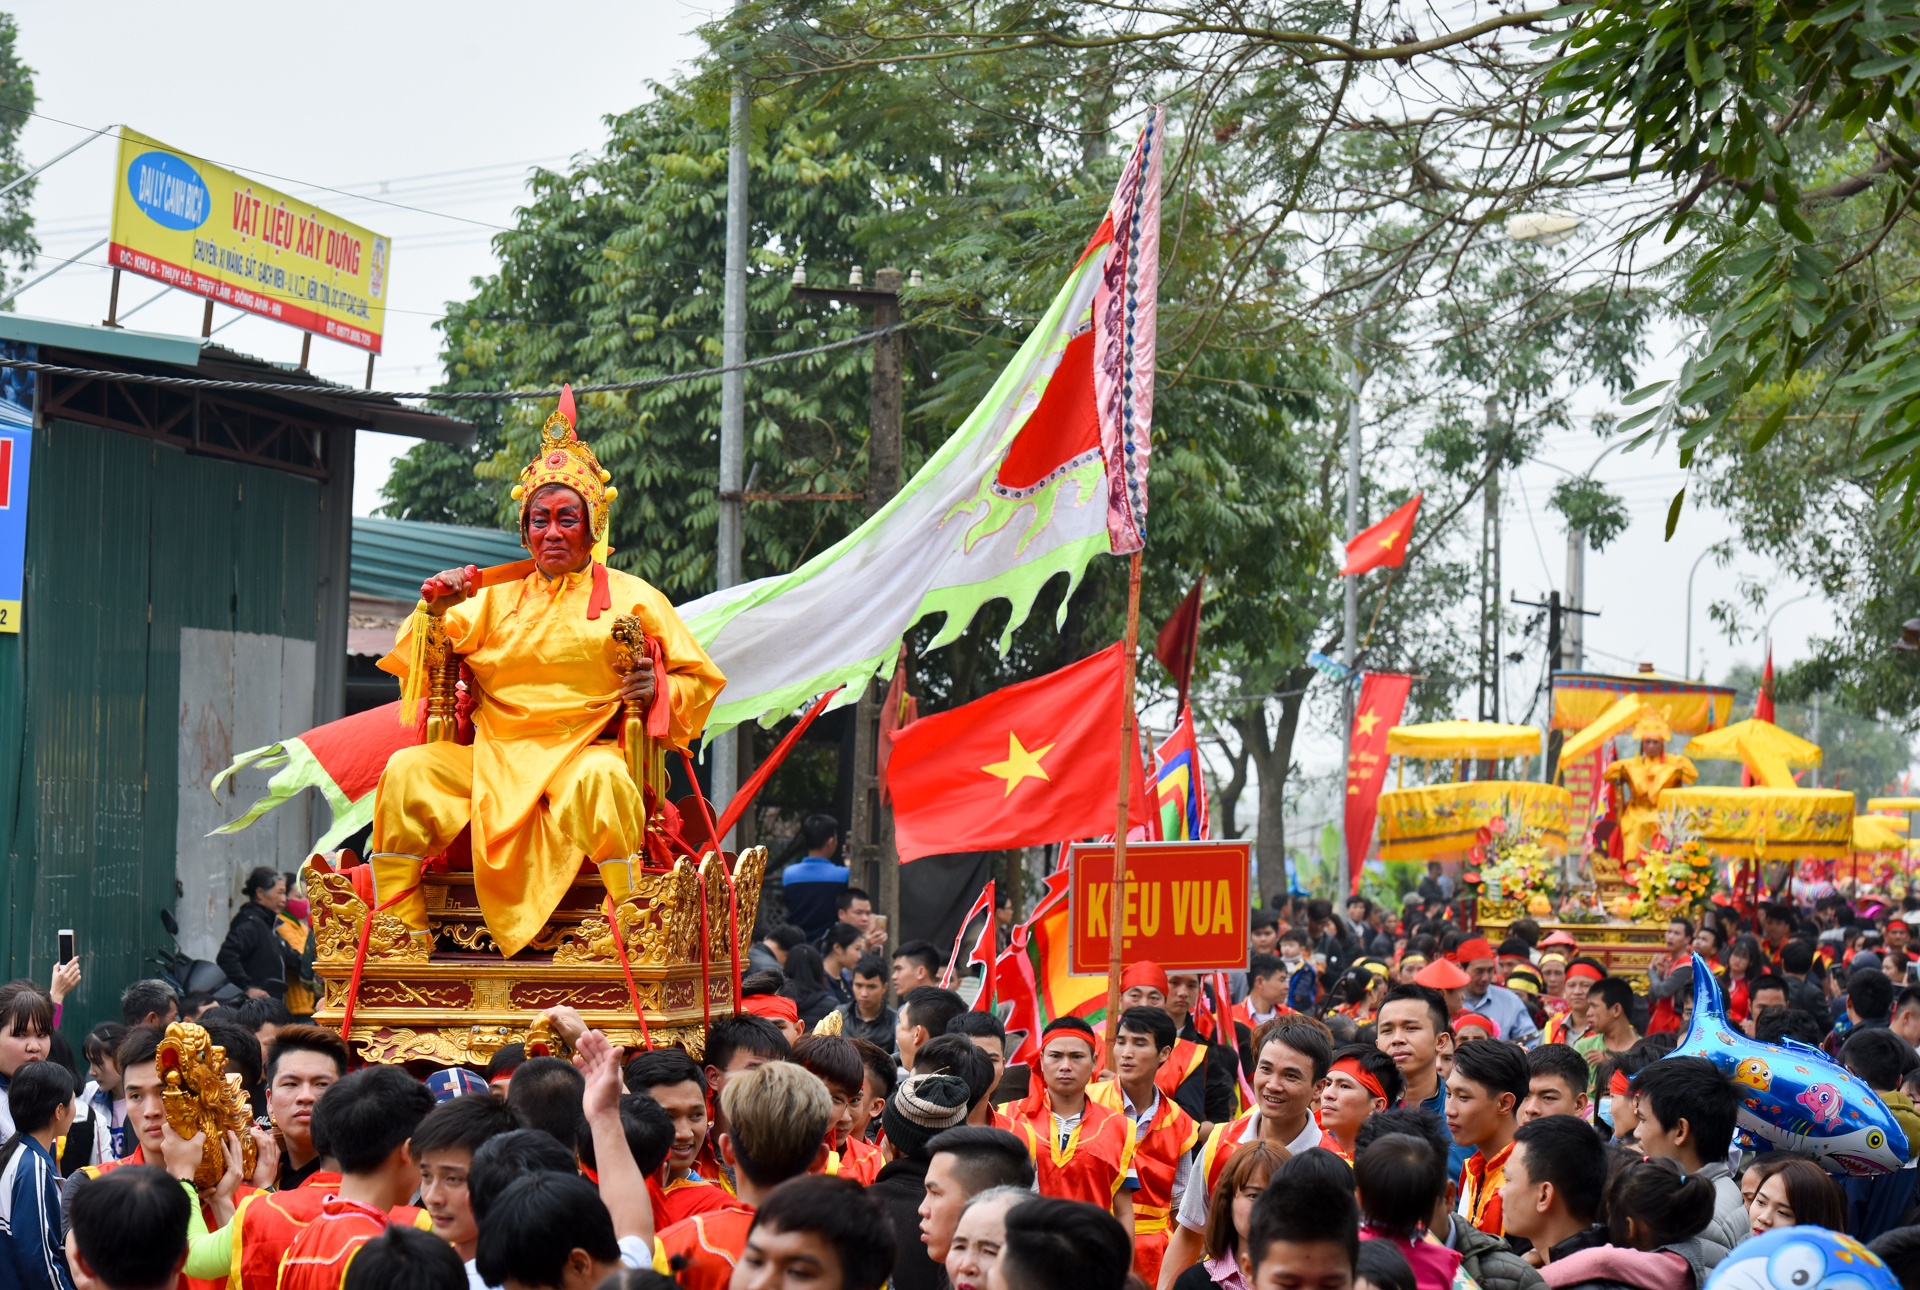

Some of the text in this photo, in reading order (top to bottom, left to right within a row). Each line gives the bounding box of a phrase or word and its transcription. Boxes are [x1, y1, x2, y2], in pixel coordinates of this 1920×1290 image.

[153, 161, 166, 208] LÝ
[233, 187, 361, 277] VẬT LIỆU XÂY DỰNG
[134, 254, 151, 272] KHU
[151, 261, 156, 274] 6
[1171, 879, 1233, 936] VUA
